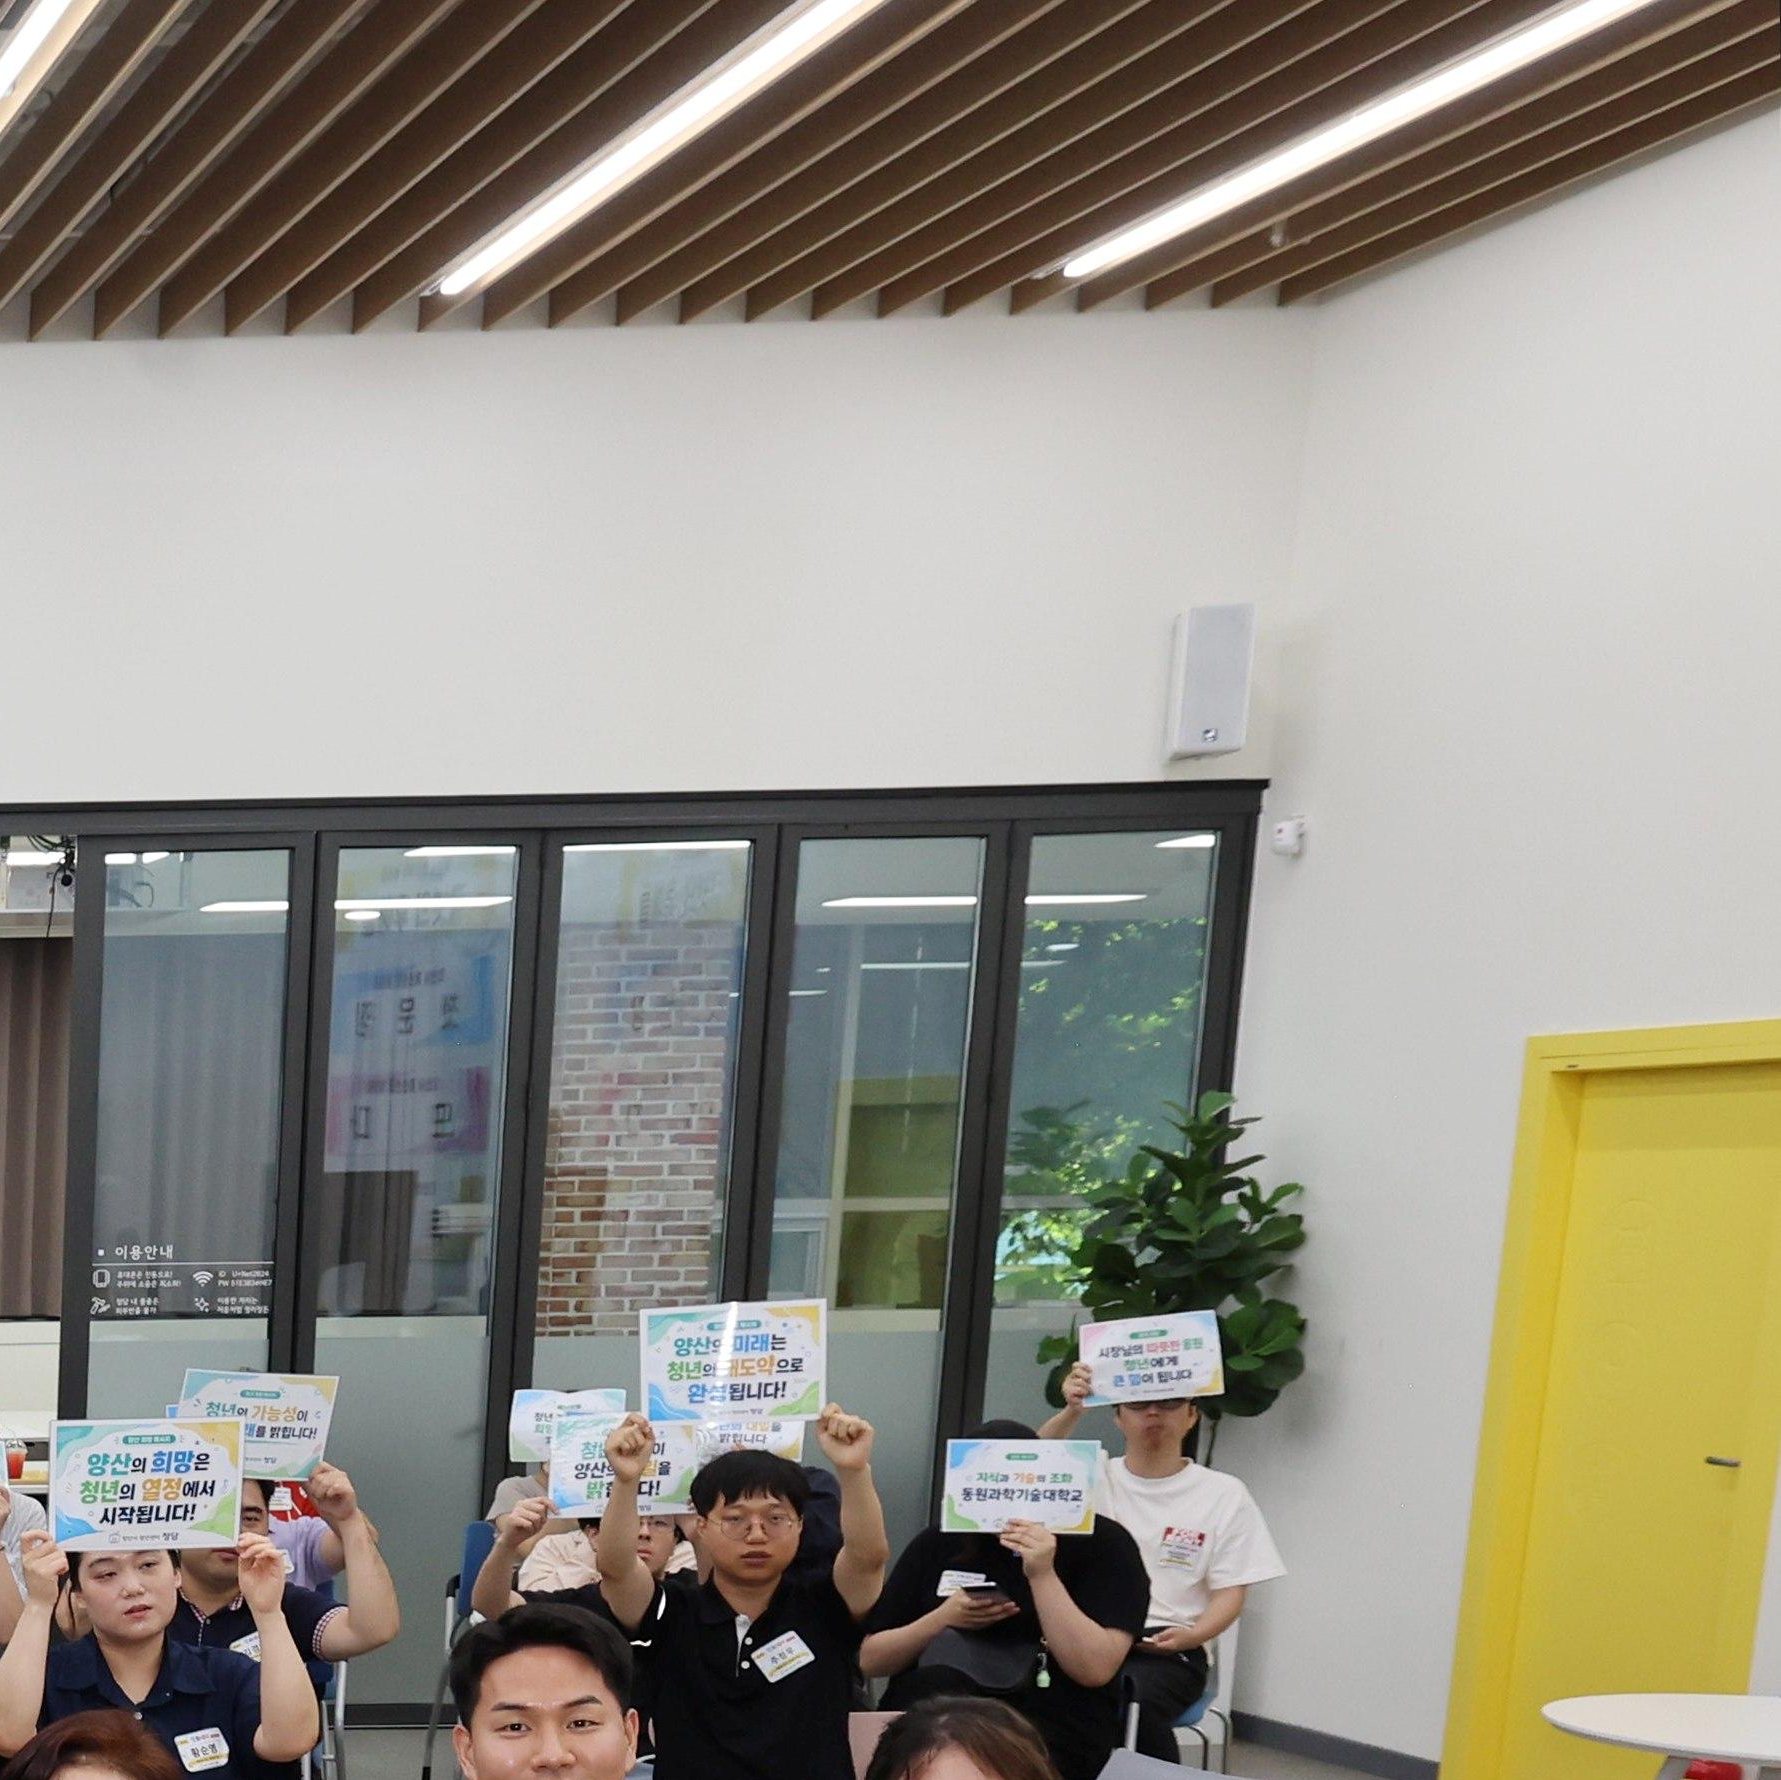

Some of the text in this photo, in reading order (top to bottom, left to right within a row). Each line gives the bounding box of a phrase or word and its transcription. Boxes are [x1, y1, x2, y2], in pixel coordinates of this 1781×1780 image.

[115, 1245, 173, 1260] 이용안내
[253, 1405, 308, 1422] 가능성이
[87, 1451, 210, 1478] 양산의 희망은
[80, 1479, 215, 1504] 청년의 열정에서
[99, 1504, 196, 1527] 시작됩니다!
